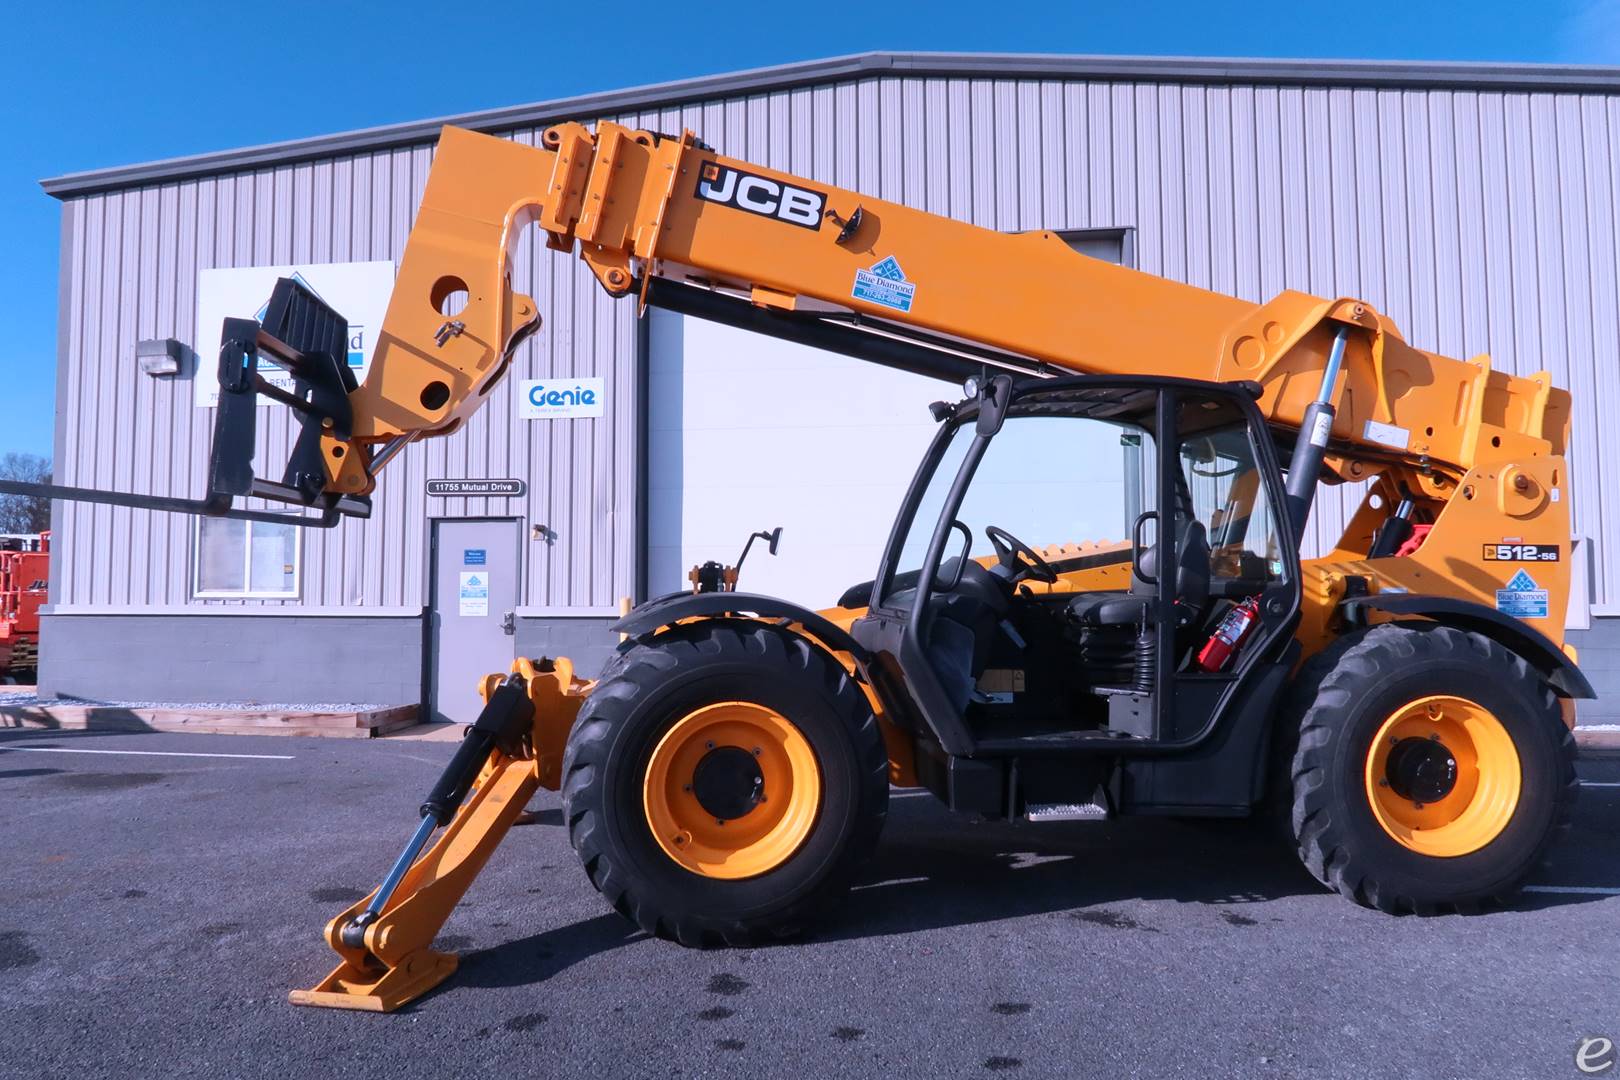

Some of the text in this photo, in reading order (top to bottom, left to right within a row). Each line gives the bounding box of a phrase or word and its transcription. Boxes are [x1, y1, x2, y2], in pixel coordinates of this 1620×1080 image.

[700, 169, 822, 226] JCB
[858, 272, 875, 283] Blue
[876, 278, 913, 294] Diamond
[529, 385, 595, 406] Genie
[435, 483, 512, 491] 11755 Mutual Drive
[1497, 545, 1557, 560] 512-56
[1498, 592, 1547, 601] Blue Diamond
